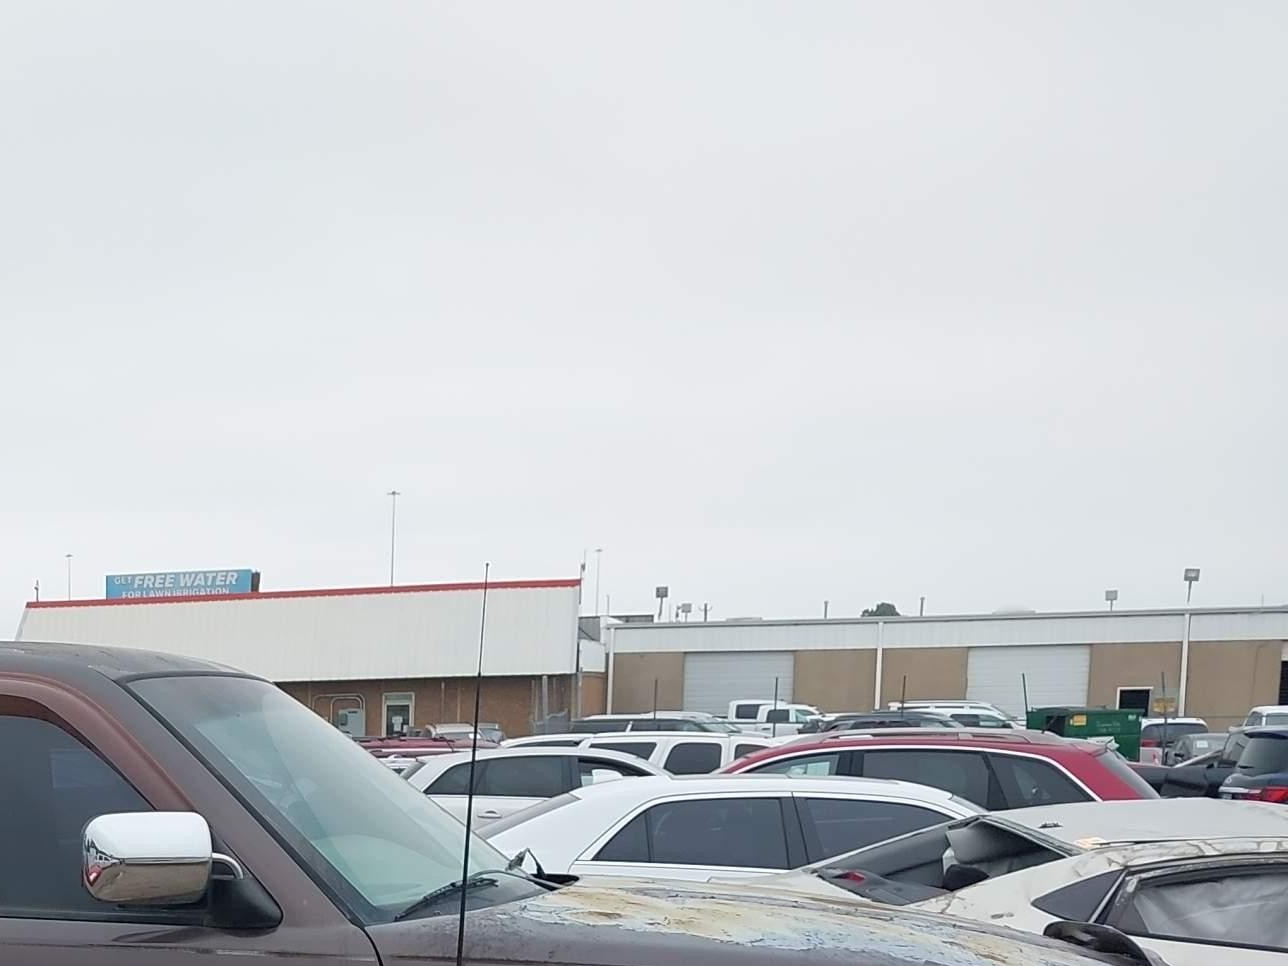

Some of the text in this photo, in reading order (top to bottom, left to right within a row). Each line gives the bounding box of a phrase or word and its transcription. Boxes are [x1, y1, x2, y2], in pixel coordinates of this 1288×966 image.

[134, 575, 175, 588] FREE
[179, 572, 237, 587] WATER
[122, 587, 230, 599] FOR LAWN IRRIGATION
